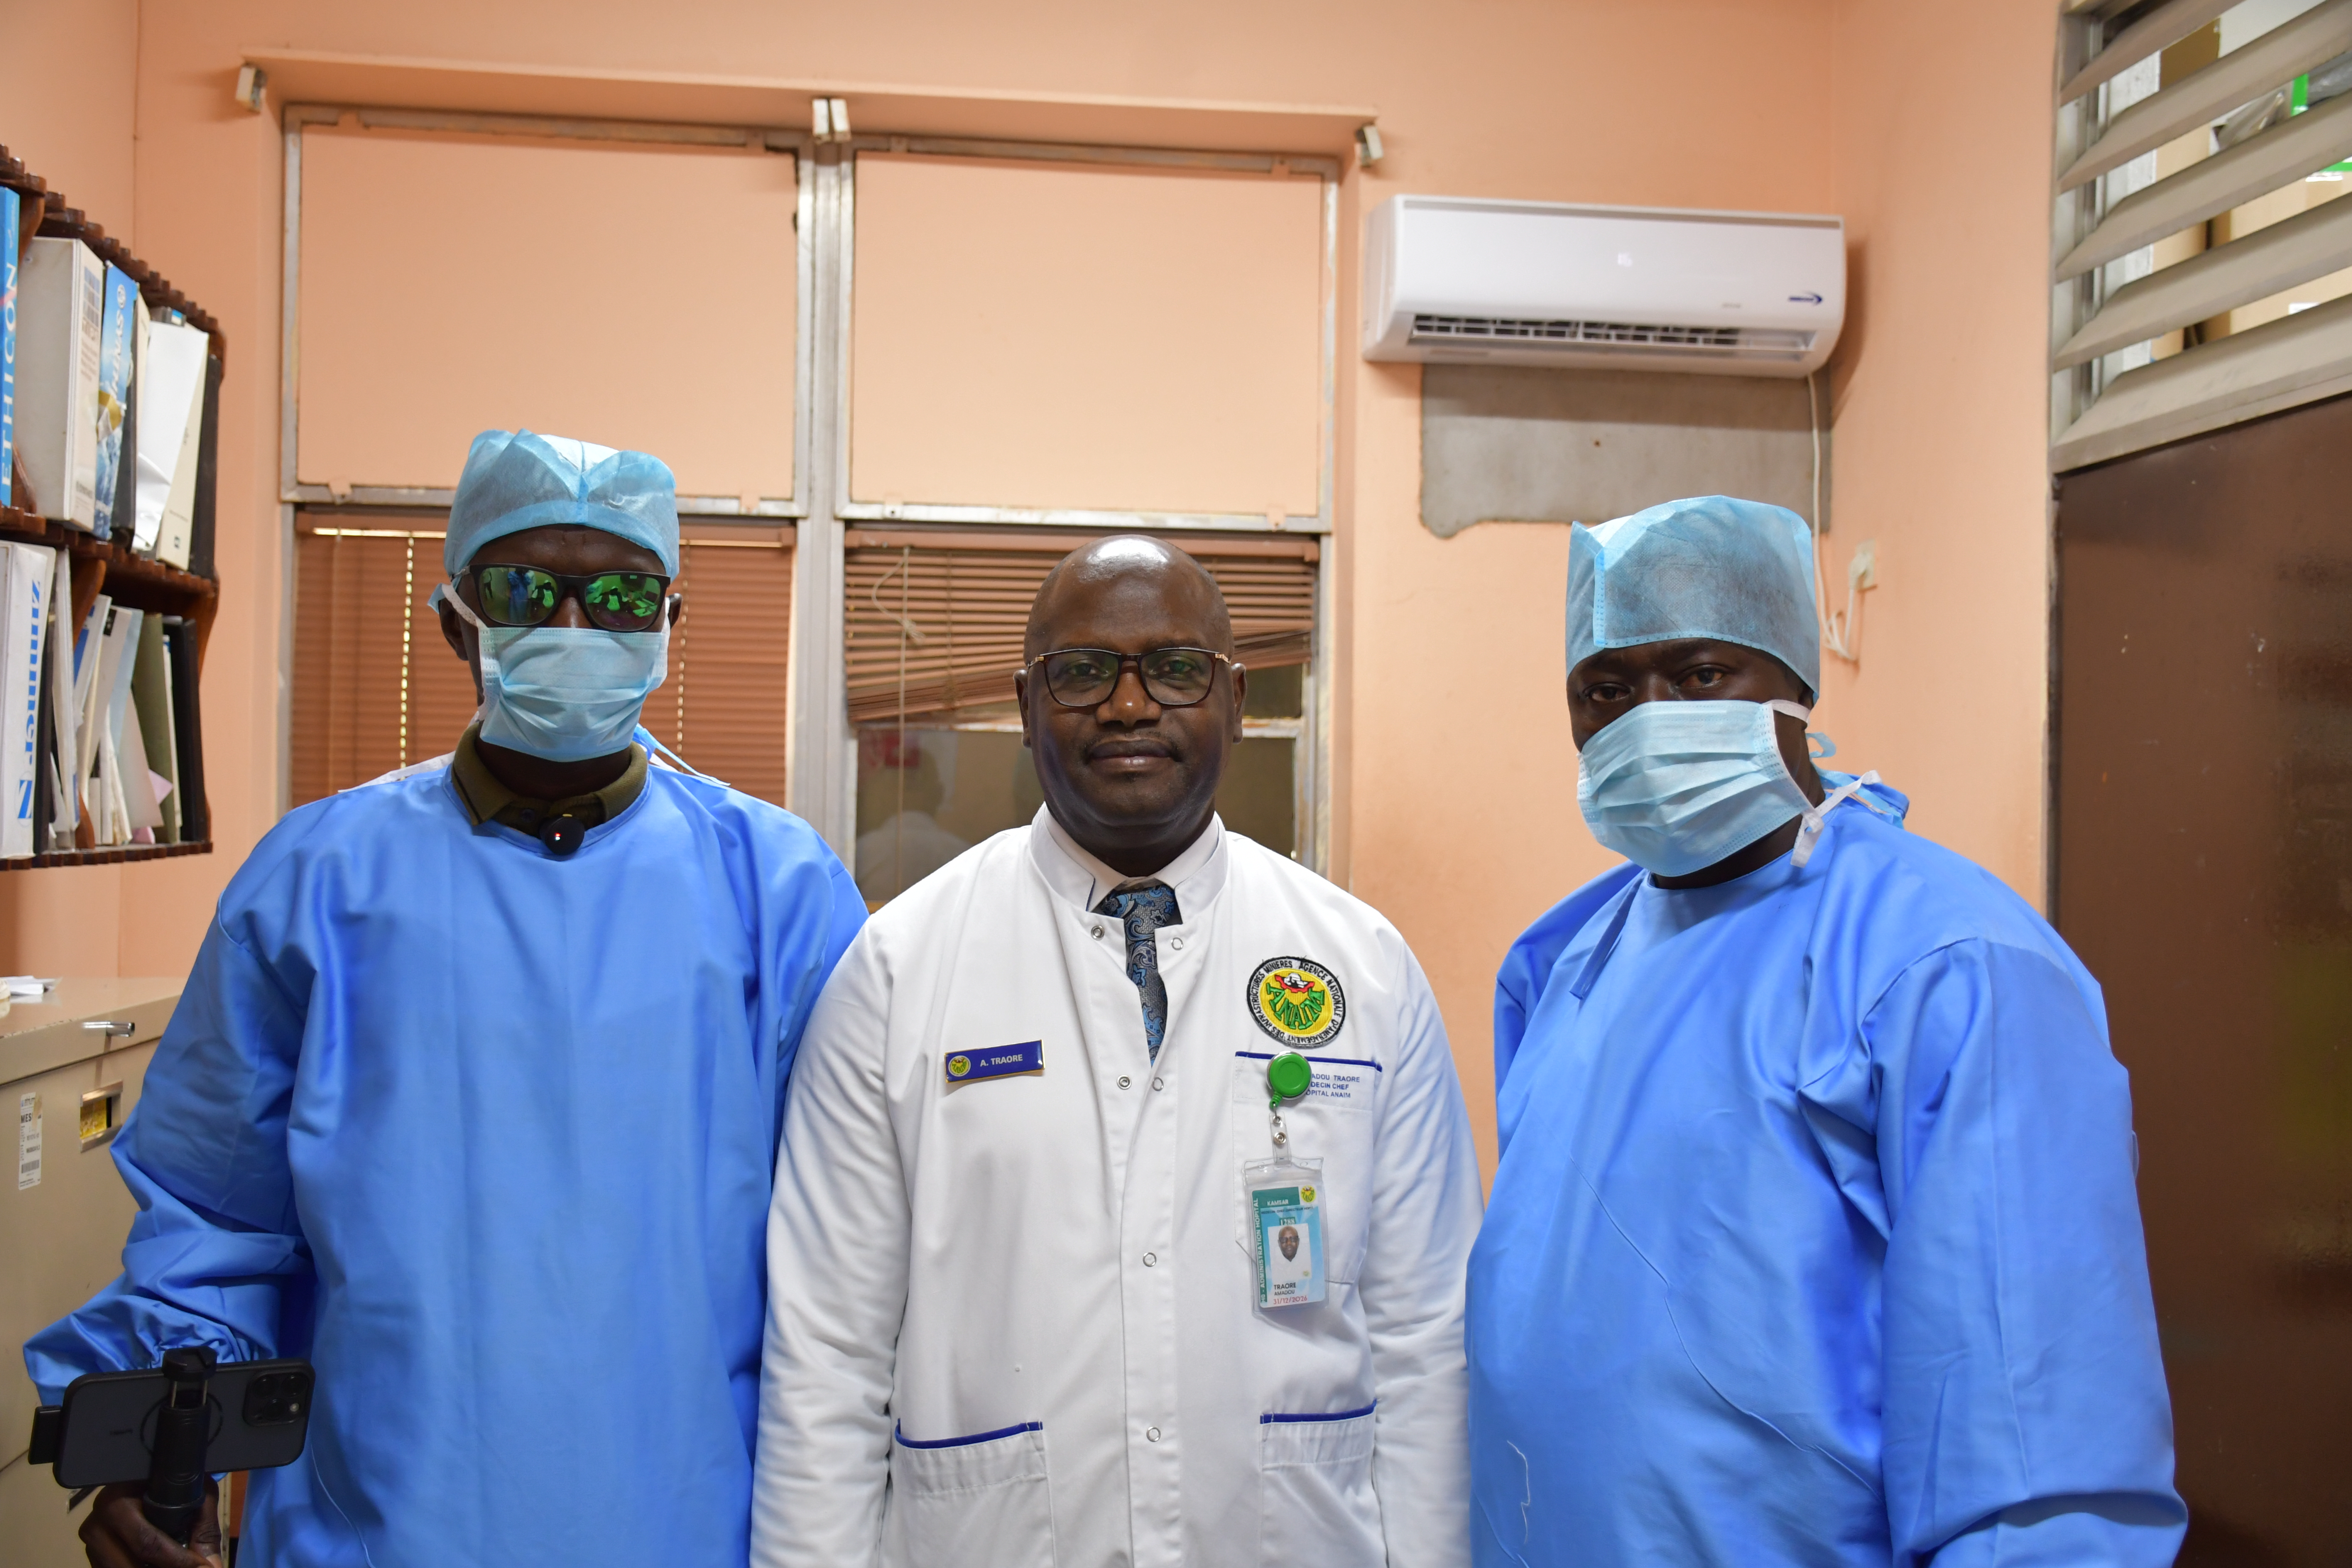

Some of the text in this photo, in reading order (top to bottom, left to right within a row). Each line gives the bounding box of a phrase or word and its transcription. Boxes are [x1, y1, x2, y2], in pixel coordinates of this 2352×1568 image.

[2, 262, 17, 487] ETHICON
[1263, 960, 1293, 974] MINIERES
[1299, 960, 1328, 980] AGENCE
[1251, 971, 1272, 1029] INFRASTRUCTURES
[1266, 983, 1325, 1030] ANAIM
[1326, 979, 1343, 1019] NATIONALE
[980, 1054, 1023, 1067] A. TRAORE
[1255, 1229, 1265, 1288] ADMINISTRATION
[1273, 1295, 1307, 1304] 31/12/2026
